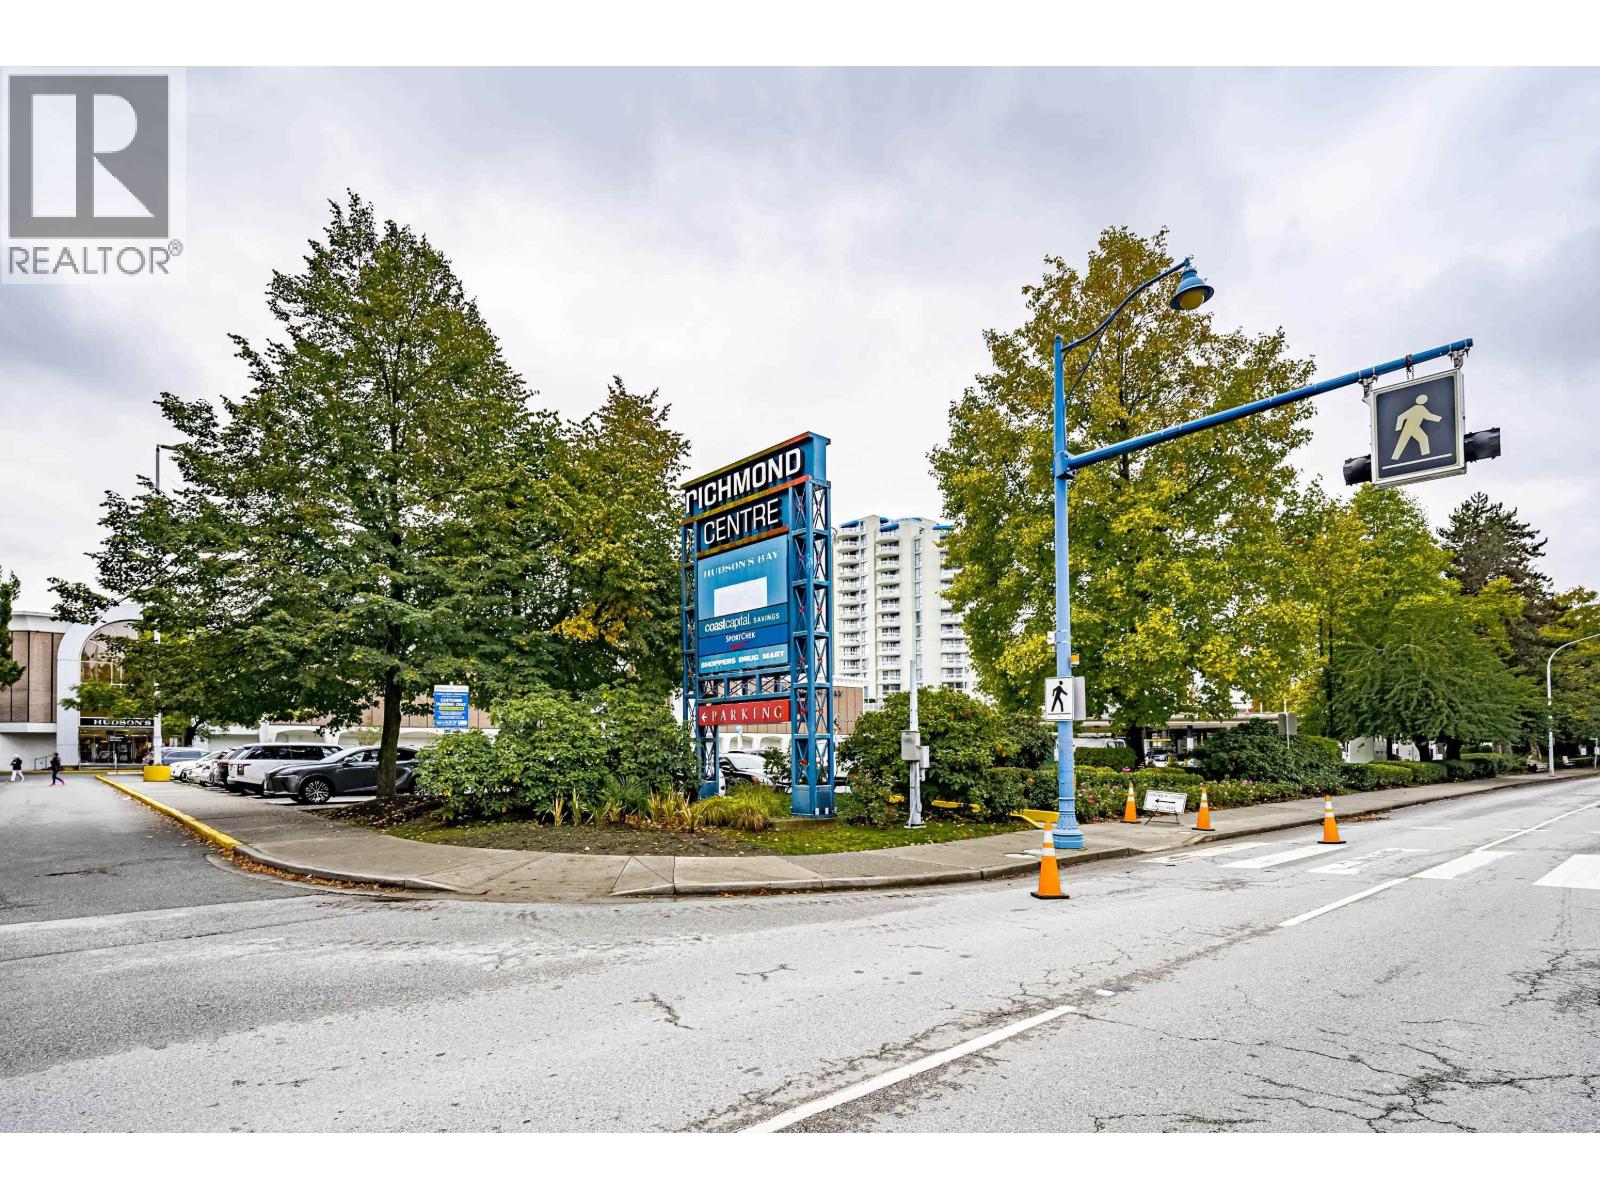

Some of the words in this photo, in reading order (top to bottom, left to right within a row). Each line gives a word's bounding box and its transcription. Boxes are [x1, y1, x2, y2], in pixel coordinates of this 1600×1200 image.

[704, 498, 779, 545] CENTRE
[757, 550, 779, 565] BAY
[753, 612, 780, 624] SAVINGS
[700, 657, 737, 669] SHOPPERS
[738, 653, 760, 663] DRUG
[762, 650, 785, 659] MART
[711, 705, 783, 722] PARKING
